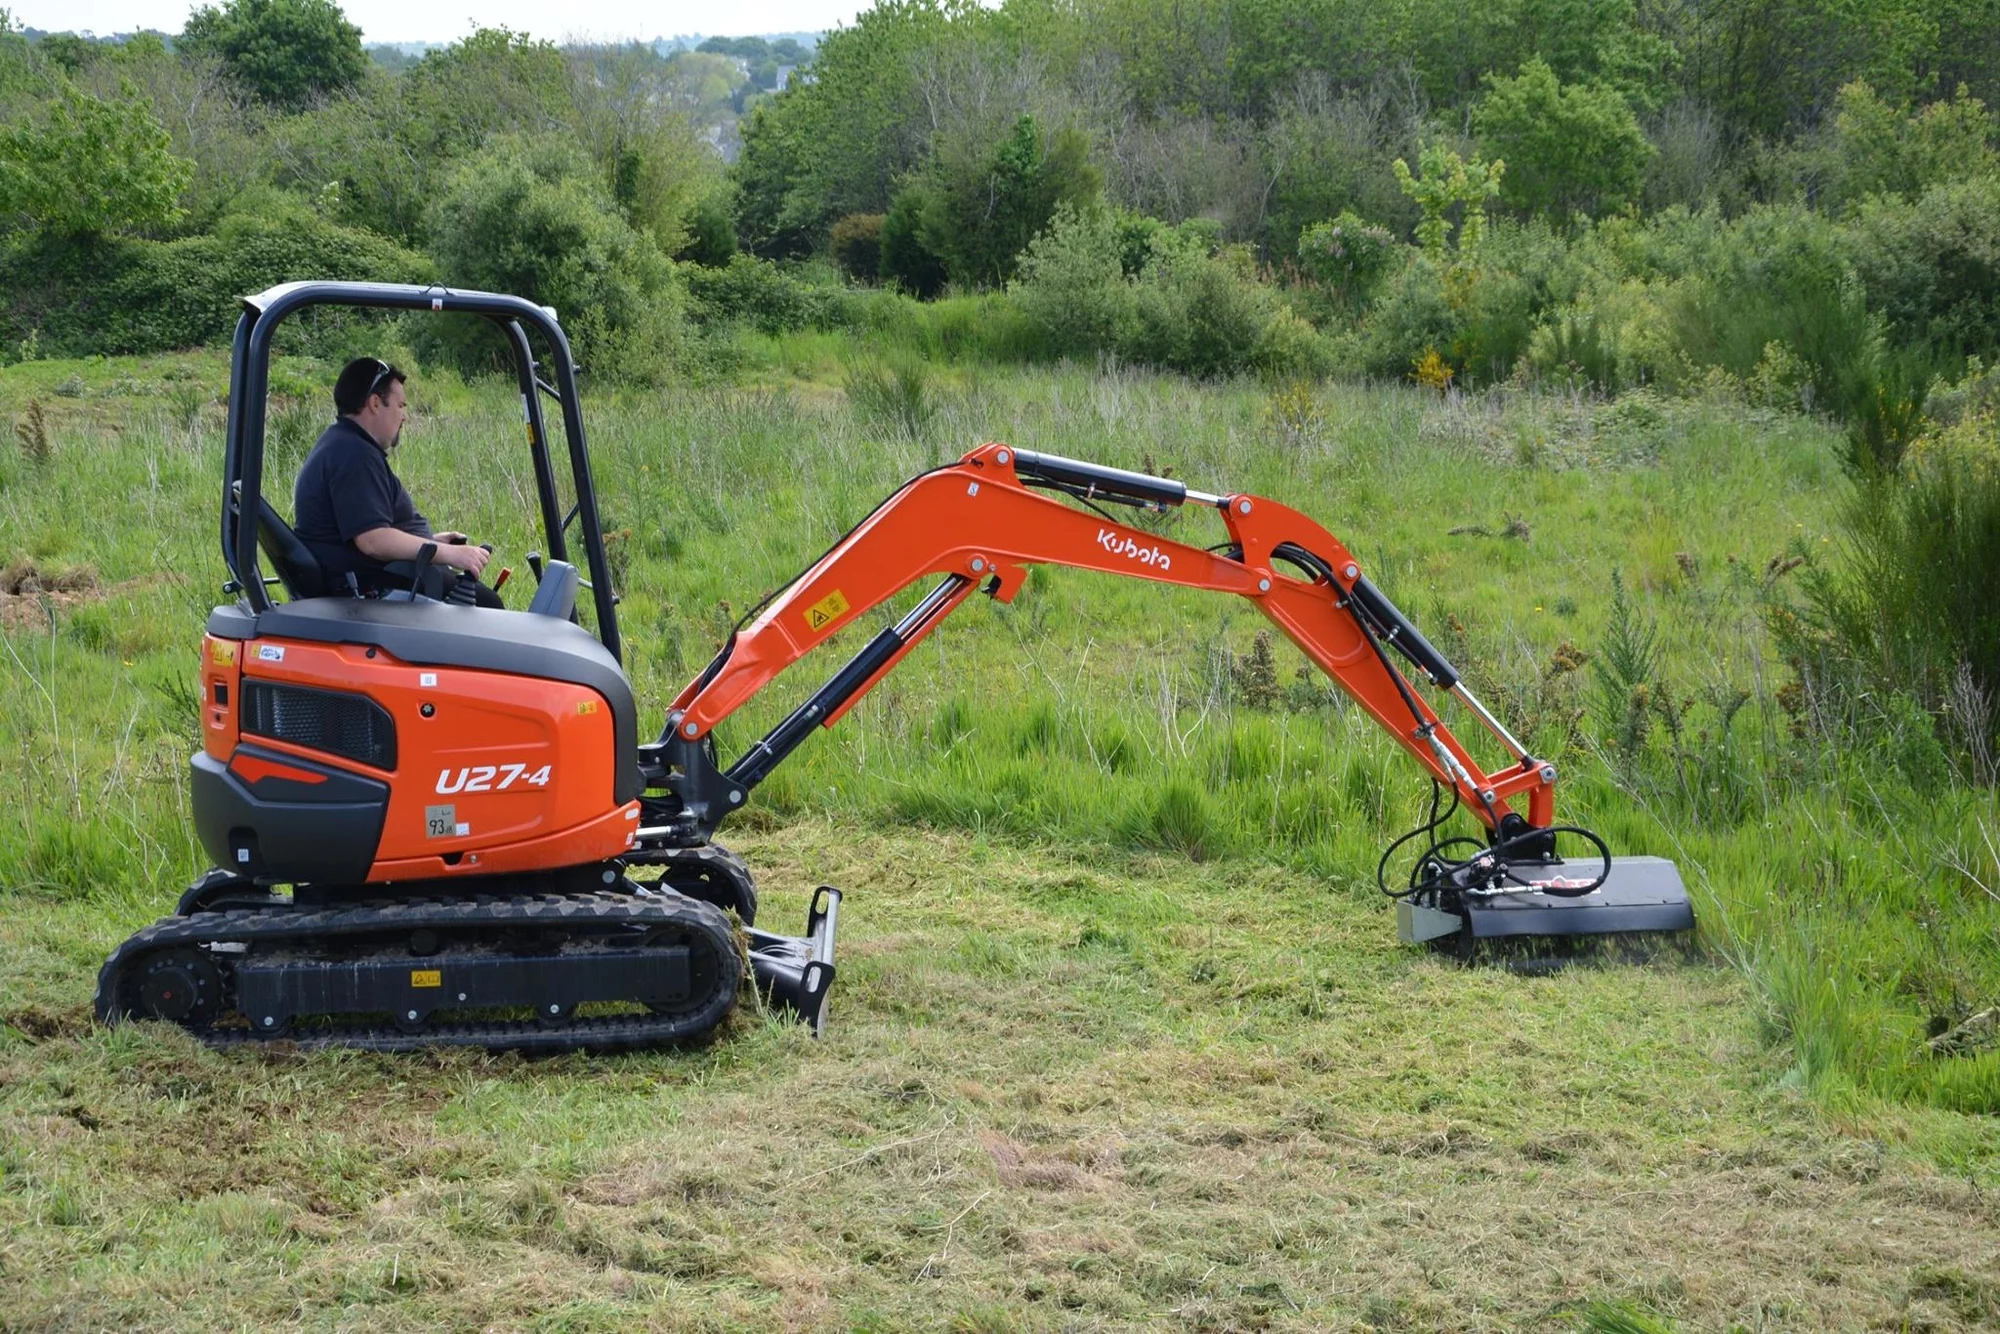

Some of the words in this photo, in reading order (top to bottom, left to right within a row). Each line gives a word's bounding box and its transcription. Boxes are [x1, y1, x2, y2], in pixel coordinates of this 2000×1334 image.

[1096, 528, 1171, 570] Kubota
[435, 763, 552, 794] U27-4
[429, 819, 445, 836] 93
